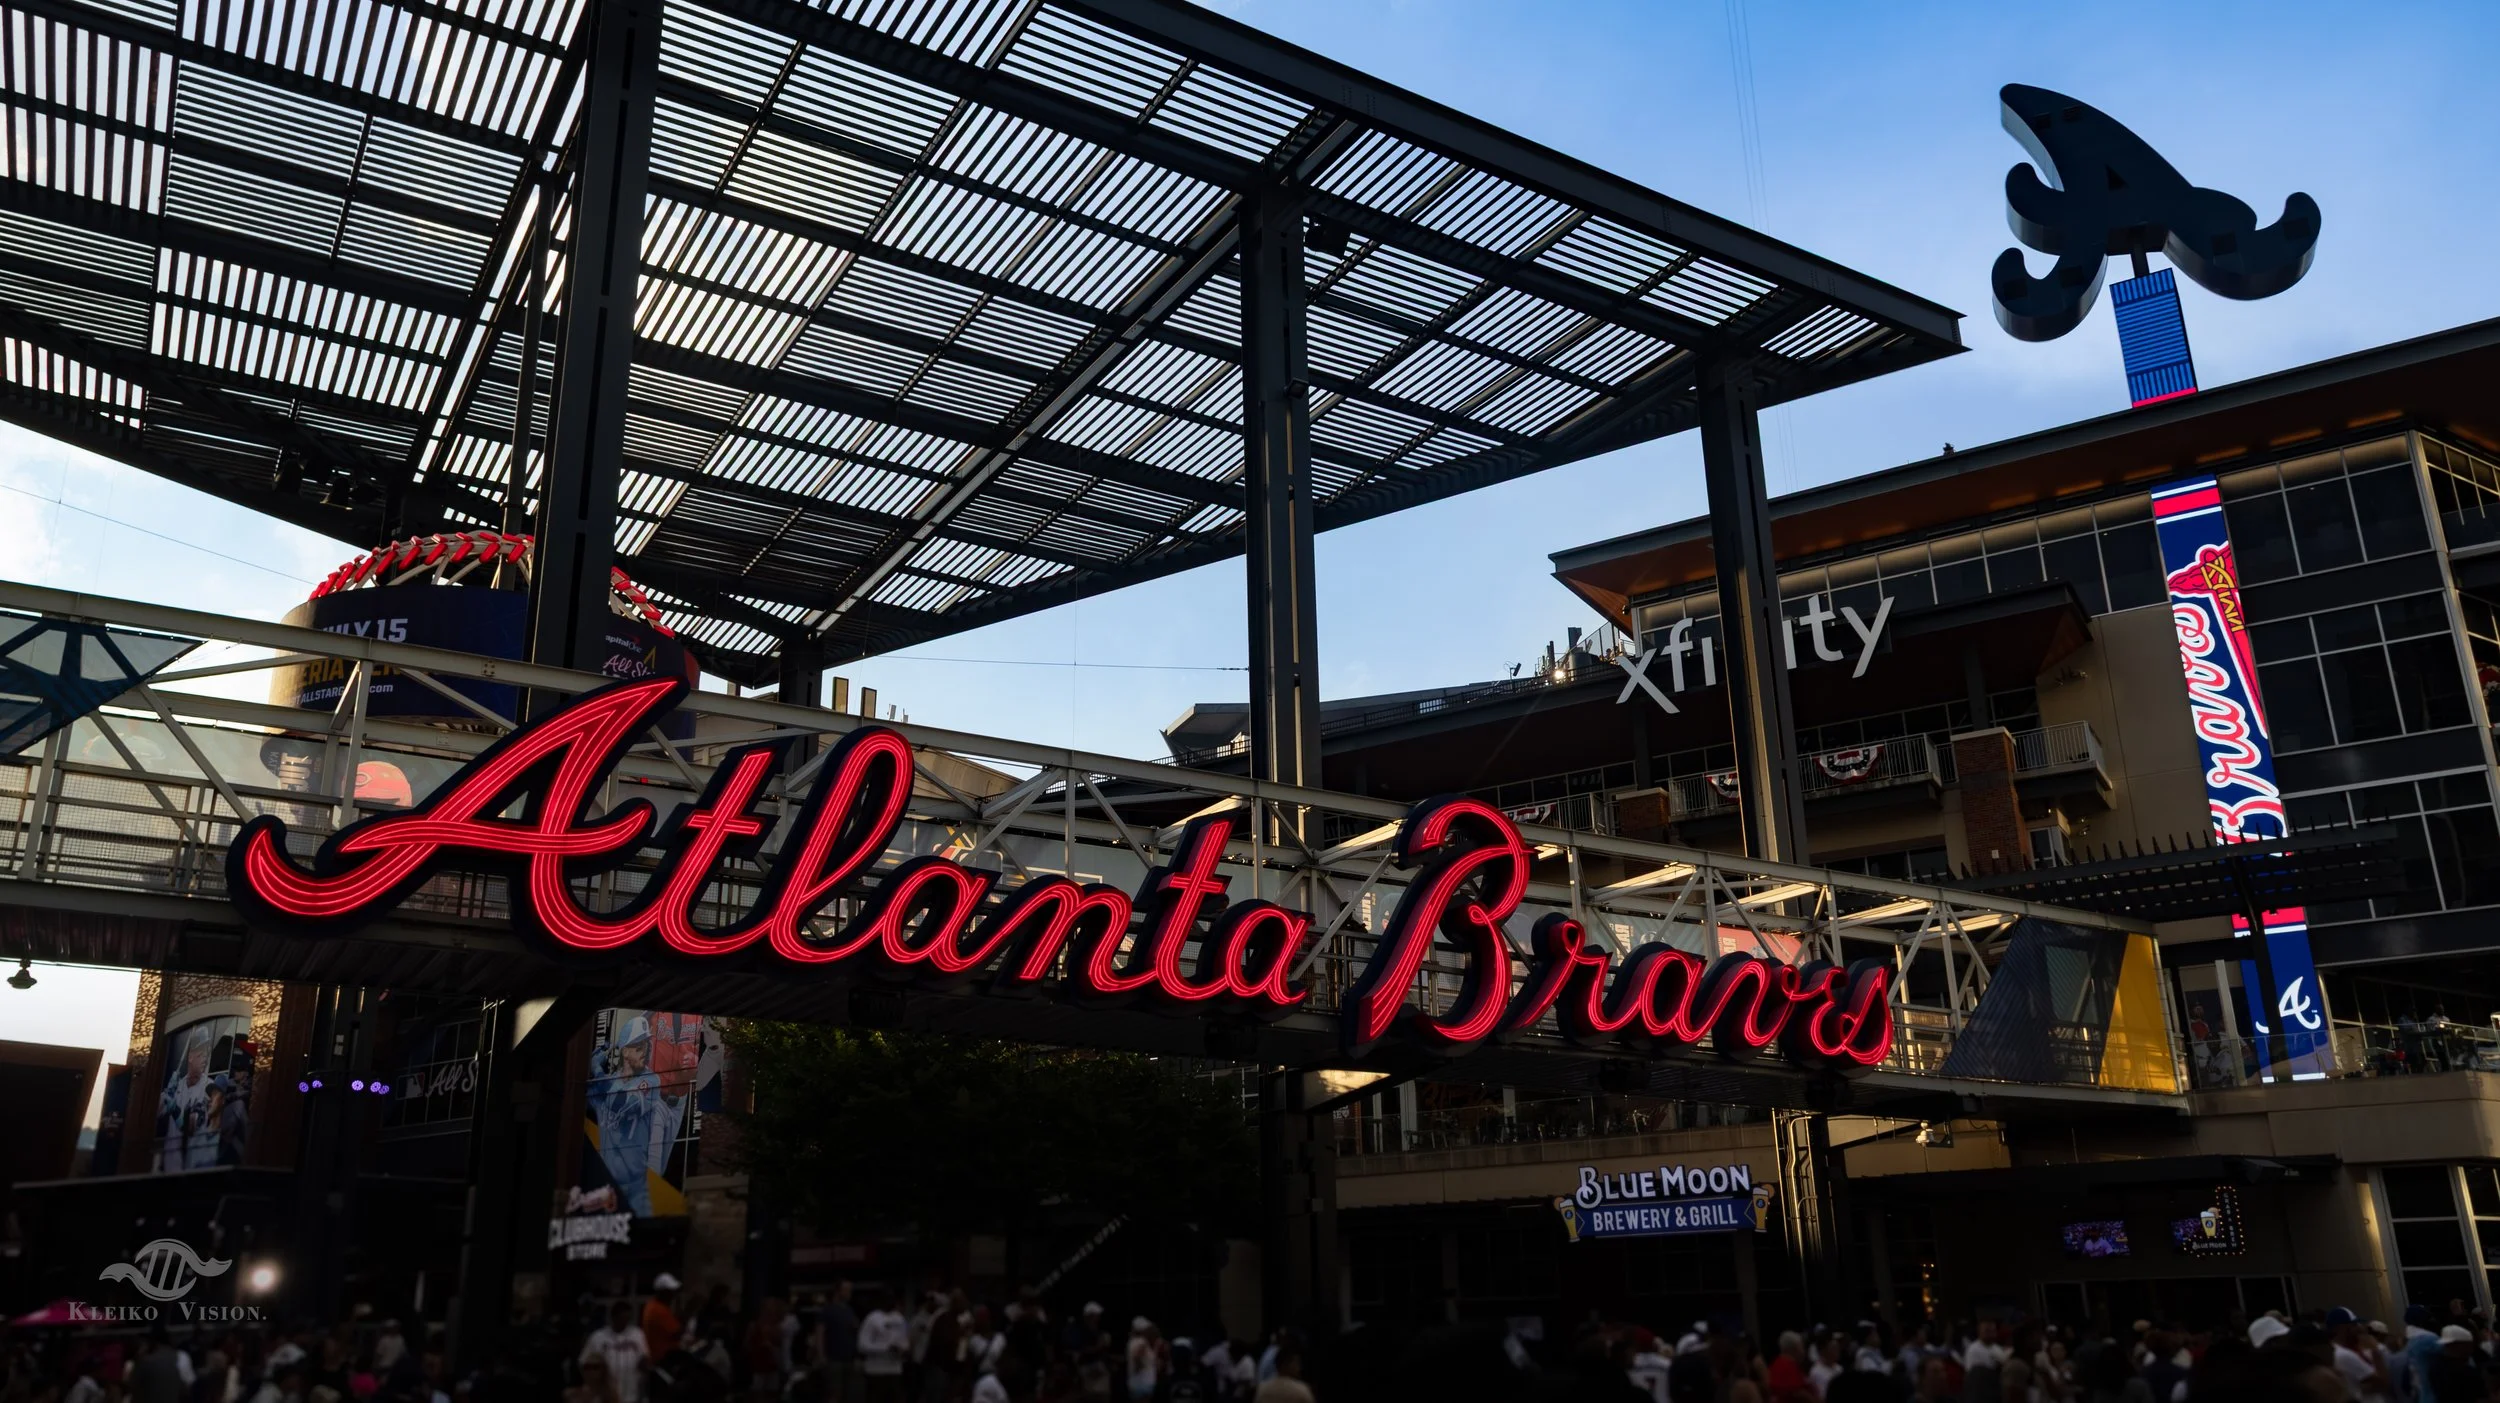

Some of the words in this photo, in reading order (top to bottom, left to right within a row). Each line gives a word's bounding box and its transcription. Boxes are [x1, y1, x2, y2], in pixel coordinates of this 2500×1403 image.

[376, 617, 409, 643] 15
[602, 653, 633, 673] All
[1615, 595, 1895, 714] xfiity
[240, 677, 1313, 1008] Atlanta
[1354, 796, 1896, 1070] Braves
[425, 1063, 464, 1096] All
[1576, 1166, 1657, 1209] BLUE
[1659, 1164, 1751, 1197] MOON
[1593, 1207, 1670, 1232] BREWERY
[1675, 1209, 1687, 1227] &
[1690, 1204, 1738, 1227] GRILL
